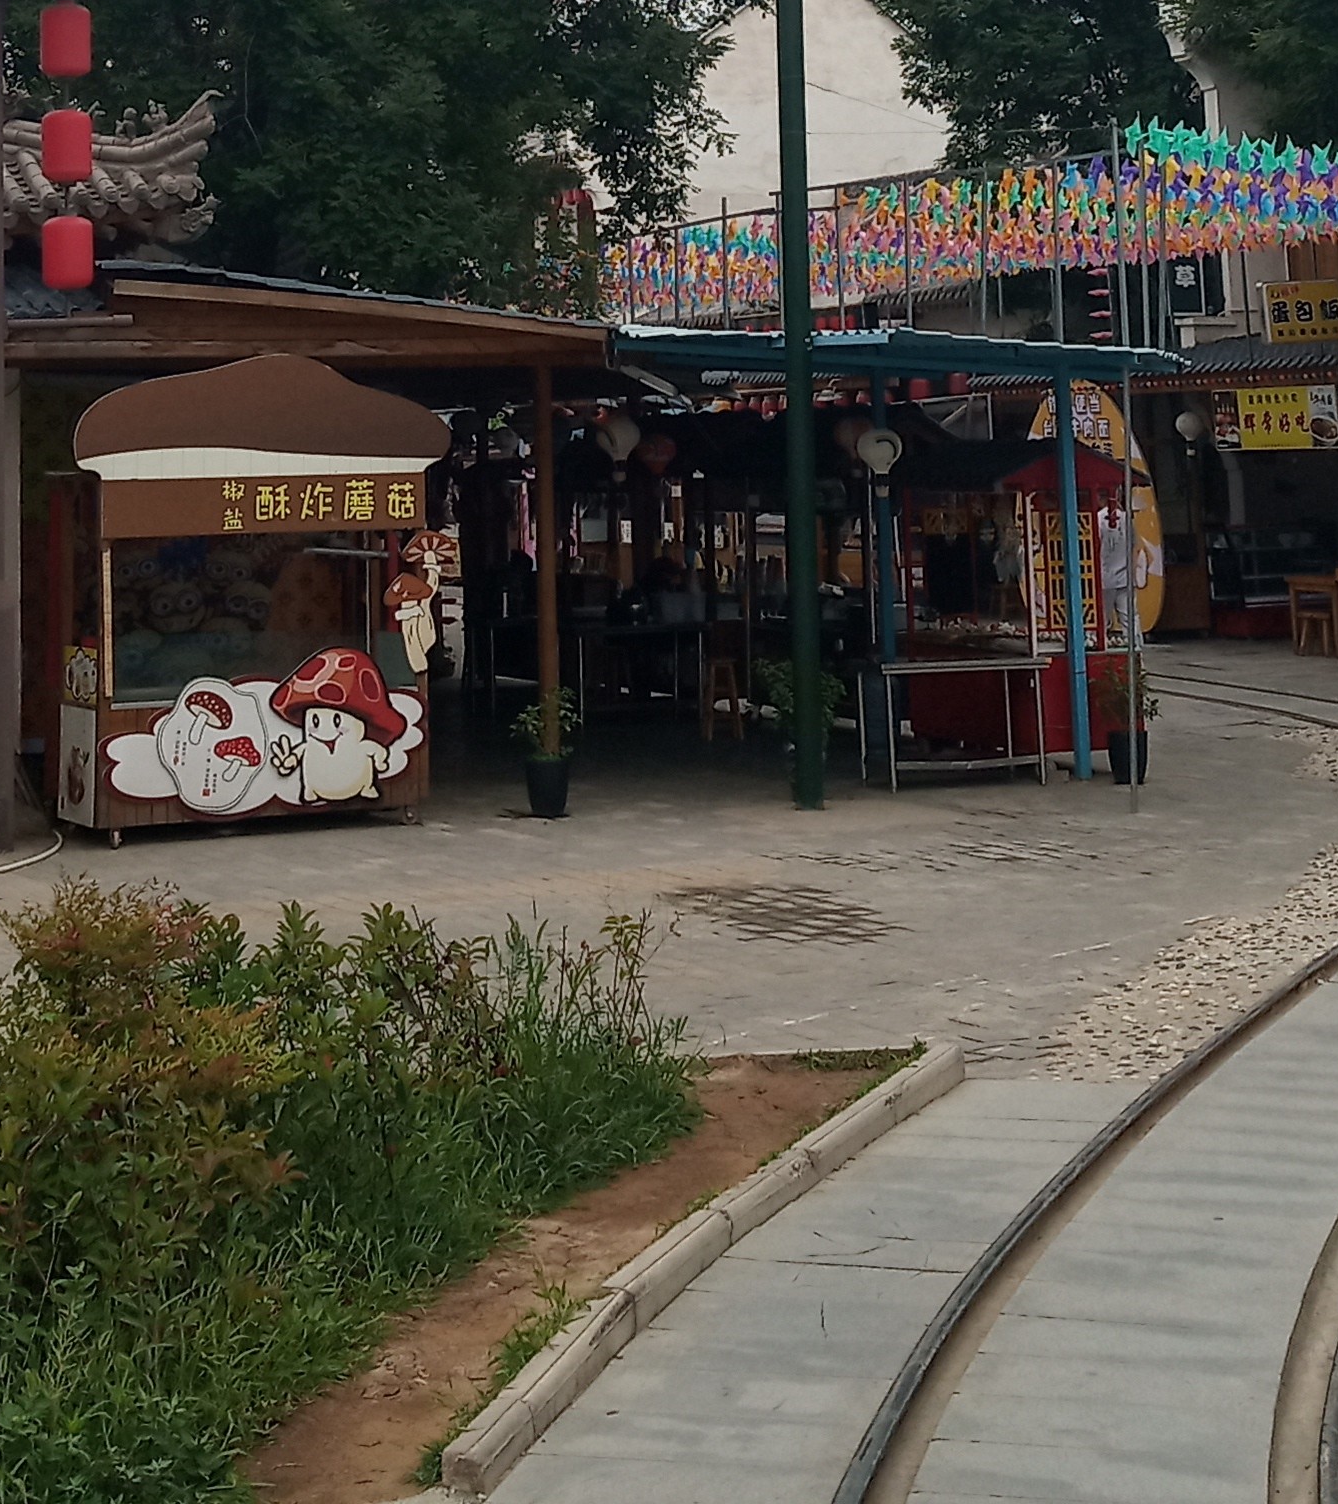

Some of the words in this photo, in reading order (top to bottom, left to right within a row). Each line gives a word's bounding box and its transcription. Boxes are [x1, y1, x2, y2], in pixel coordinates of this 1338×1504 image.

[1043, 417, 1110, 438] 台牛肉面
[222, 480, 245, 531] 椒盐
[255, 479, 416, 521] 酥炸蘑菇
